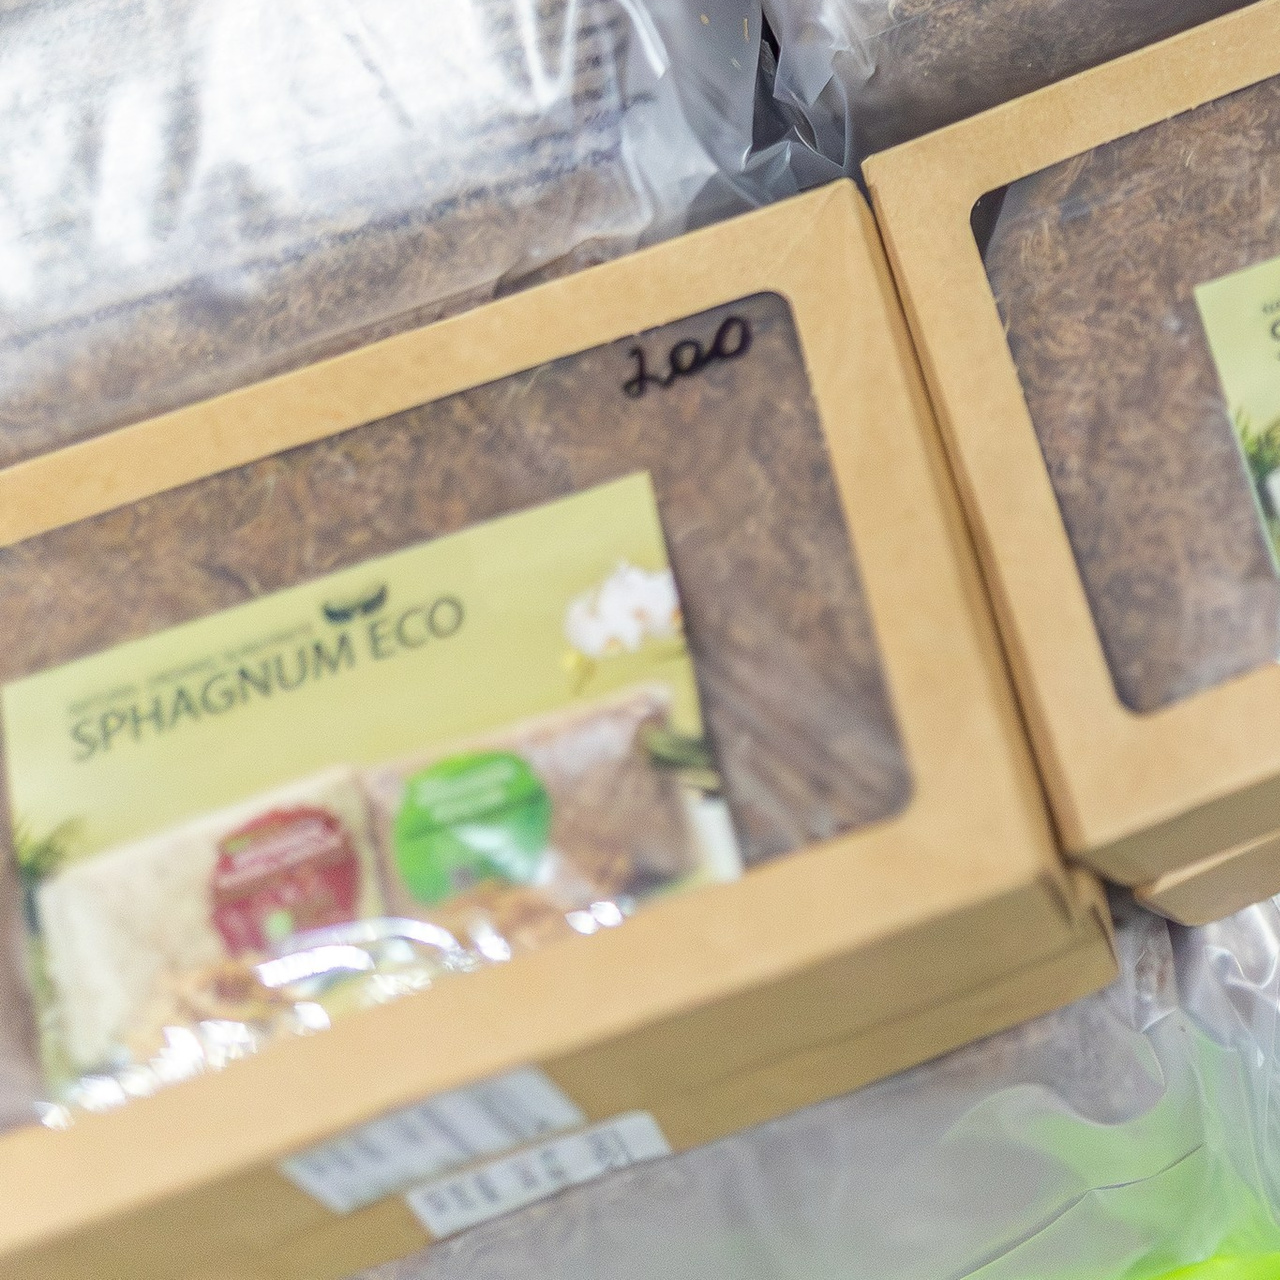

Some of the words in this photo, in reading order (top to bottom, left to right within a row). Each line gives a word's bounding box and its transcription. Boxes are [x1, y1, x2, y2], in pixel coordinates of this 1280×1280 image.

[623, 316, 752, 398] 200
[70, 630, 356, 763] SPHAGNUM
[366, 594, 465, 661] ECO
